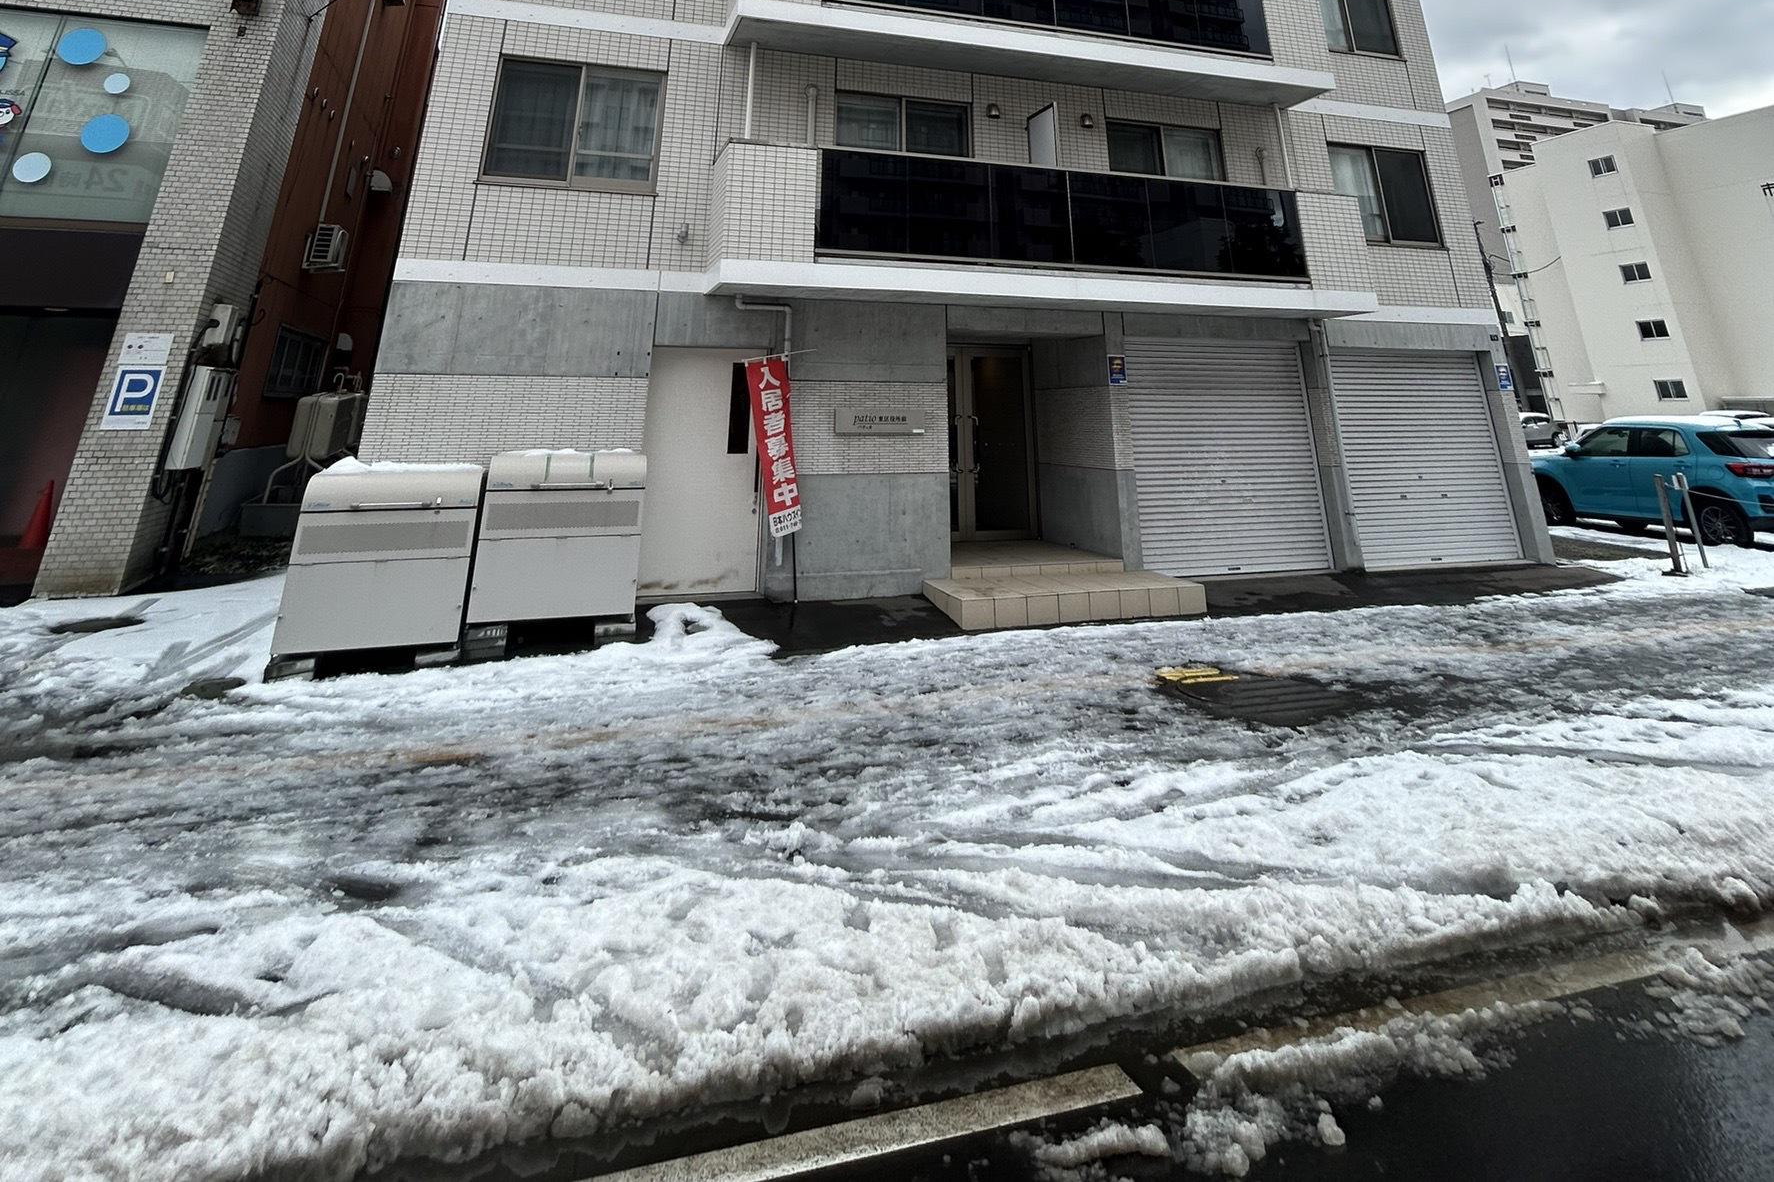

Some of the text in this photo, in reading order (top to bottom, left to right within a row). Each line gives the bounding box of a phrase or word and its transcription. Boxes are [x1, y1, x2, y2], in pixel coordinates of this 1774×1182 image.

[114, 373, 155, 412] P
[758, 366, 799, 506] 入居者募集中
[853, 414, 877, 426] patio
